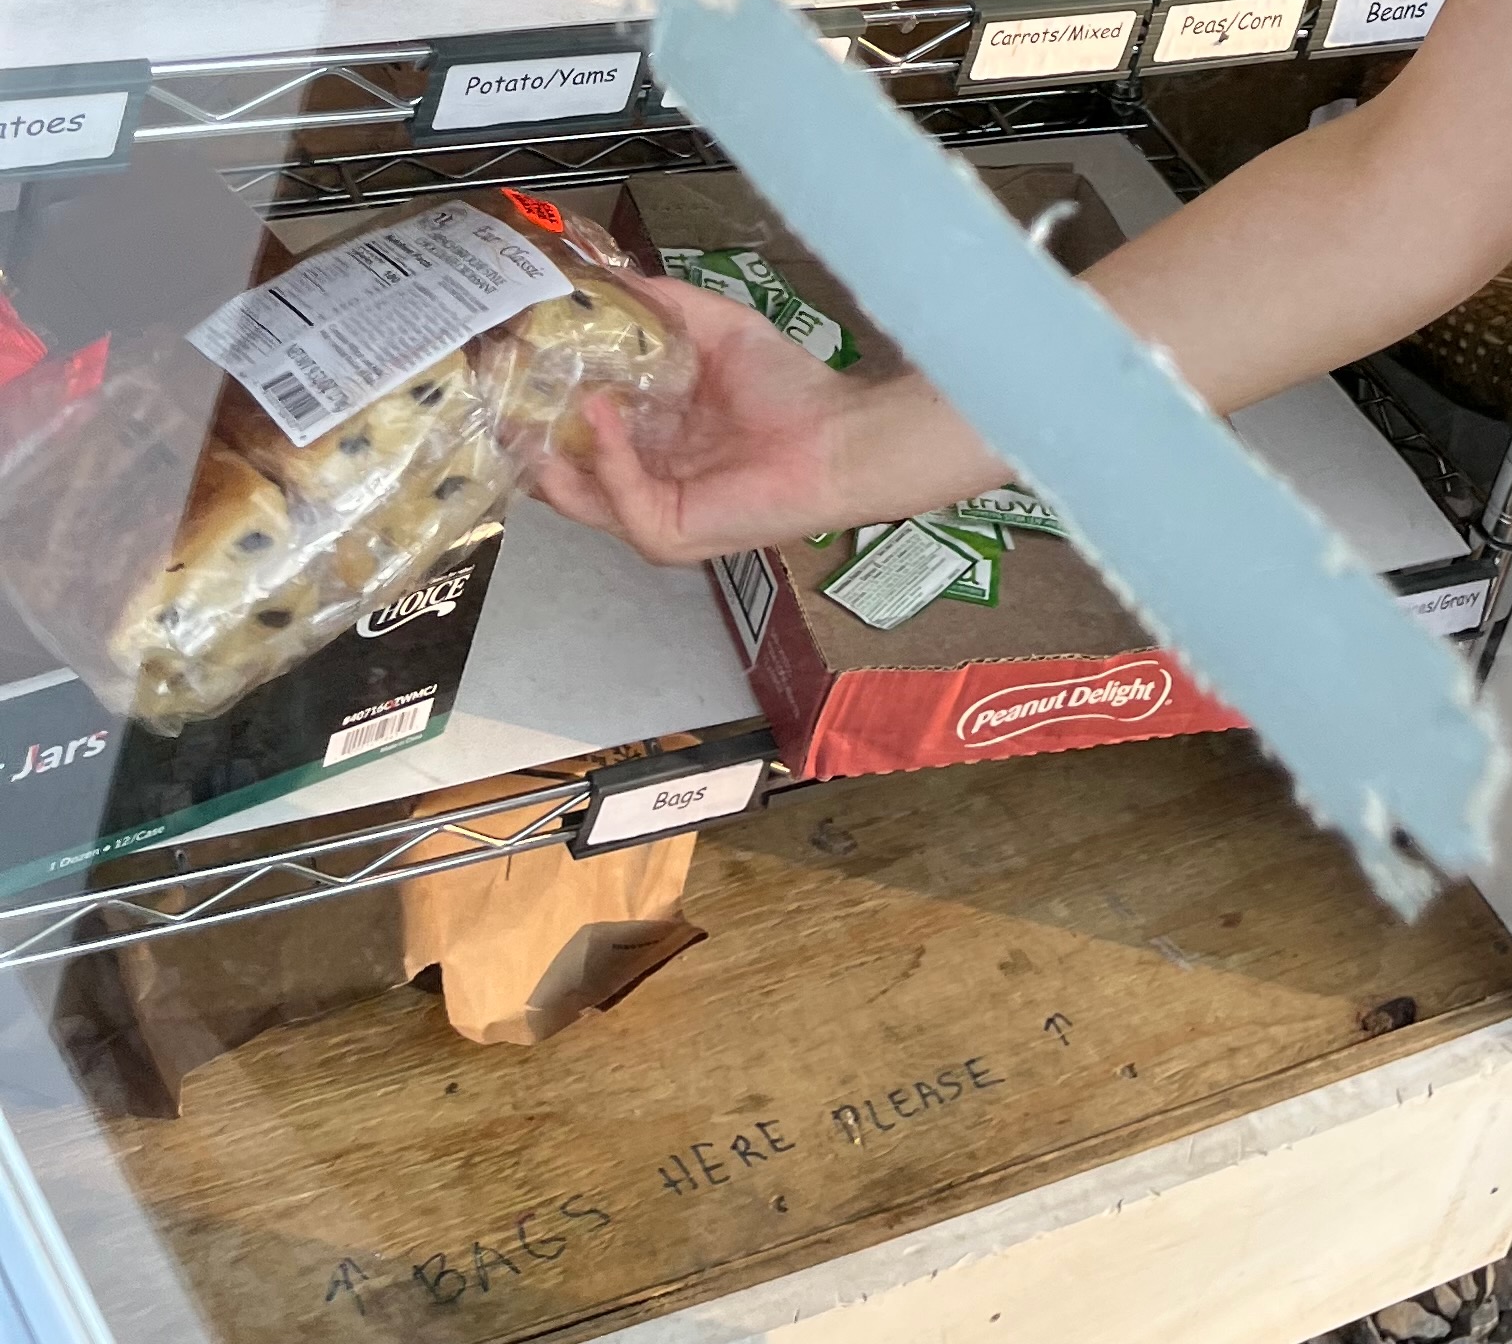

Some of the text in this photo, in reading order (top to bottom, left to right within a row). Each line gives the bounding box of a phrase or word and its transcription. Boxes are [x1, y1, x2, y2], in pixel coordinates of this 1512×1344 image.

[1179, 12, 1284, 36] Peas/Corn
[1365, 1, 1429, 23] Beans
[989, 22, 1125, 47] Carrots/Mixed
[464, 65, 619, 97] Potato/Yams
[500, 245, 545, 279] Classic
[356, 573, 472, 639] CHOICE
[969, 668, 1157, 734] Peanut Delight
[9, 729, 110, 782] Jars
[652, 786, 707, 811] Bags
[59, 848, 100, 868] Dozen
[410, 1055, 1008, 1307] BAGS HERE PLEASE
